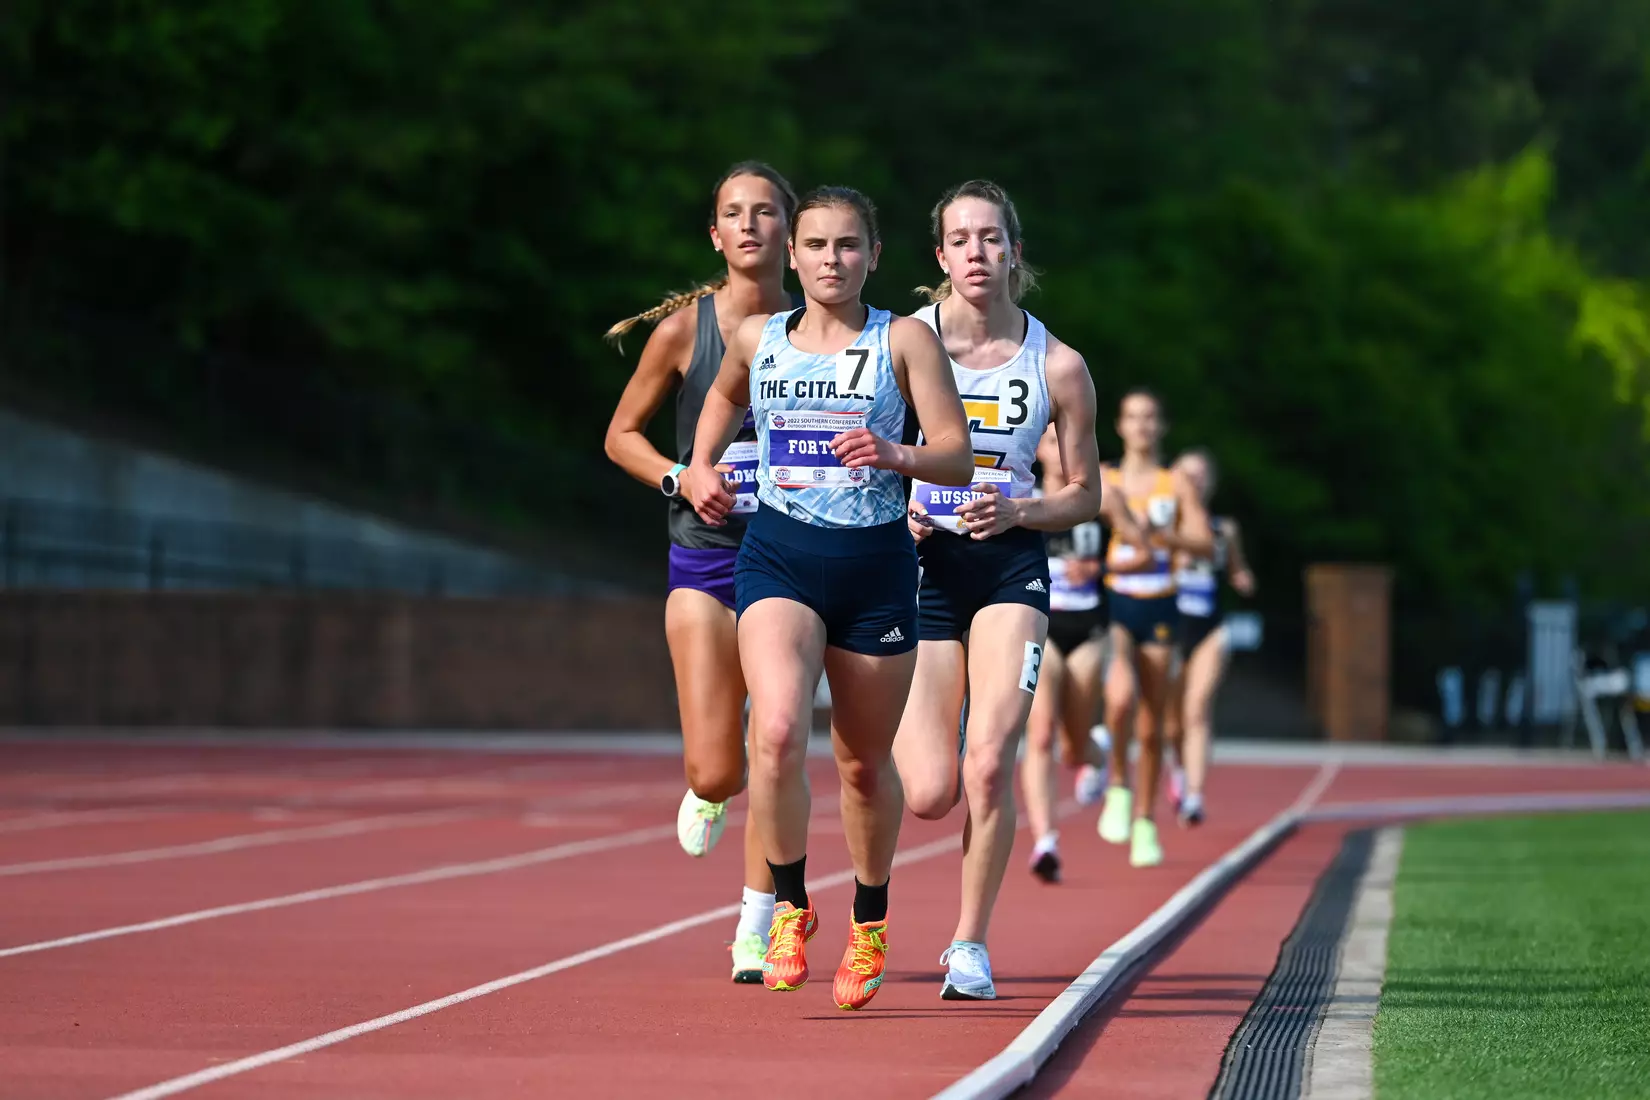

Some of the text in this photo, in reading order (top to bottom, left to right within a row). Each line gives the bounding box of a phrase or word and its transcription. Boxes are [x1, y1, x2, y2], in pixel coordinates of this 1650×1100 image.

[845, 349, 870, 391] 7
[760, 380, 875, 401] THE CITA
[1006, 379, 1029, 425] 3
[788, 439, 836, 455] FORT
[880, 635, 905, 643] adidas
